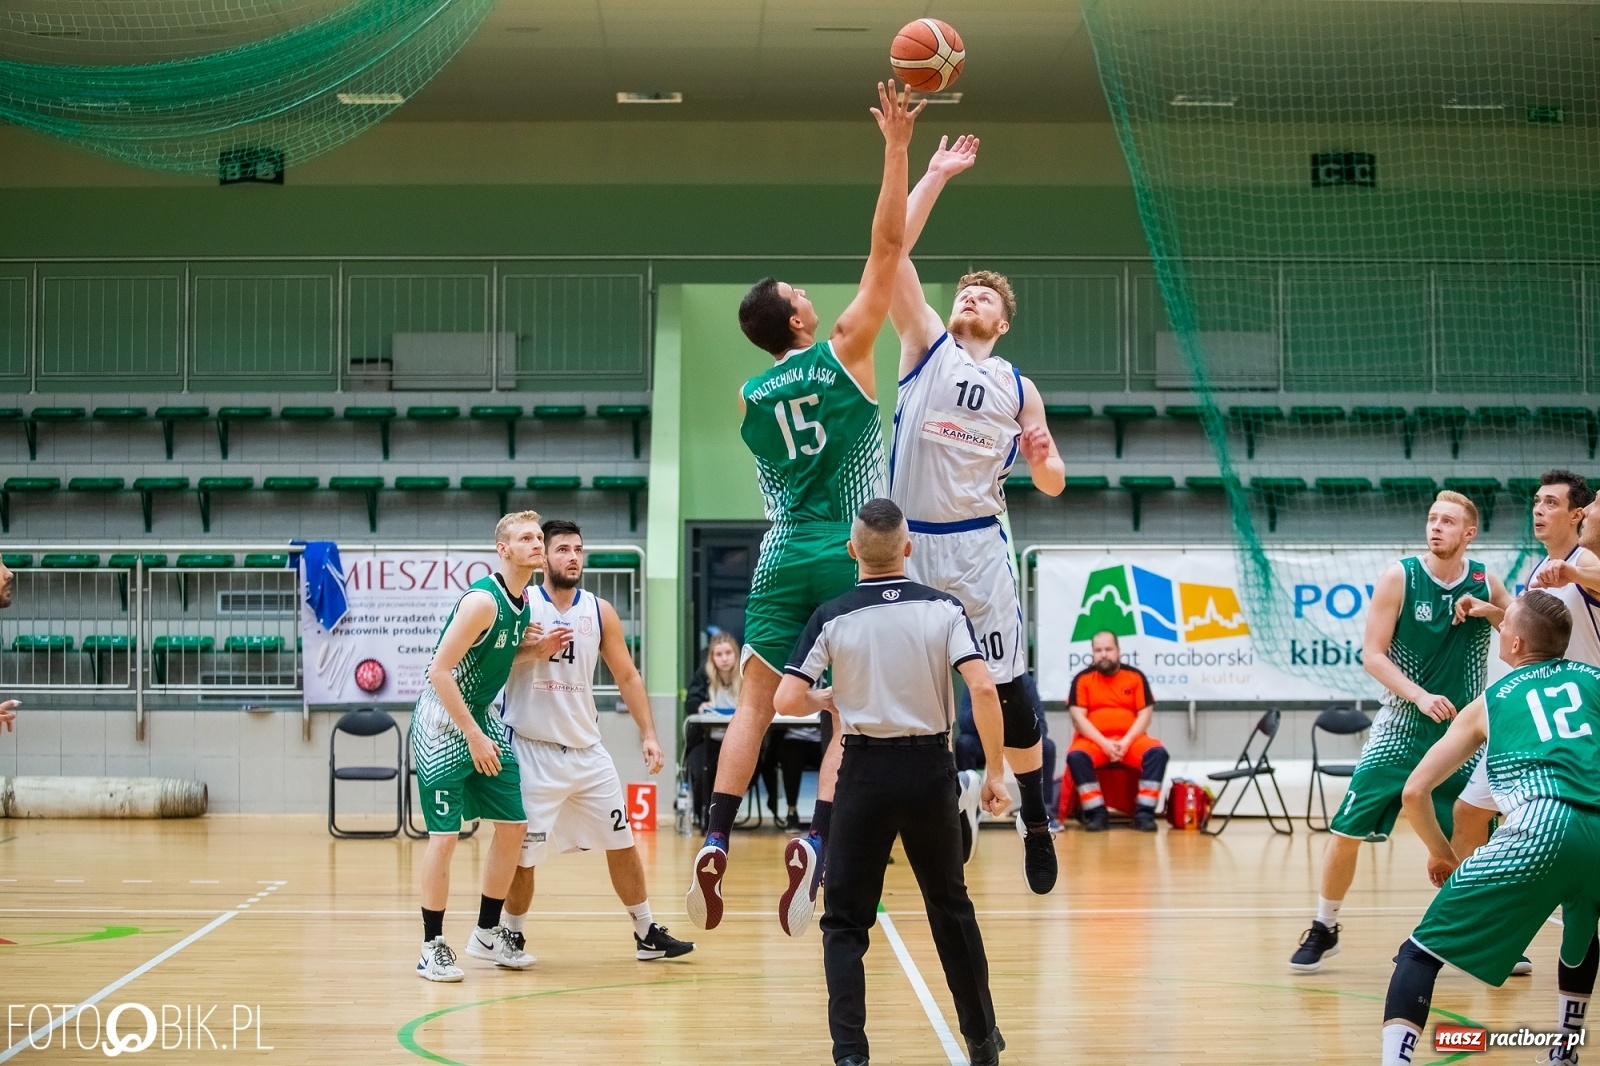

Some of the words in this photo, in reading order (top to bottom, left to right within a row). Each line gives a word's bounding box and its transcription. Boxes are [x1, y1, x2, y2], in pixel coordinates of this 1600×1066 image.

[748, 367, 804, 405] POLITECHNIKA
[807, 364, 837, 386] ŚLĄSKA
[955, 380, 986, 411] 10
[774, 393, 827, 460] 15
[942, 428, 986, 445] KAMPKA
[1294, 584, 1374, 620] PO
[1442, 594, 1454, 616] 7
[332, 627, 389, 636] Pracownik
[341, 614, 379, 625] perator
[384, 612, 436, 624] urządzeń
[511, 620, 521, 647] 5
[980, 631, 1004, 661] 10
[1069, 650, 1140, 672] poat
[1154, 648, 1254, 667] raciborski
[1202, 672, 1253, 685] kultur
[1496, 664, 1562, 699] POLITECHNIKA
[1525, 681, 1593, 743] 12
[435, 789, 450, 816] 5
[631, 786, 652, 821] 5
[1343, 790, 1357, 816] 7
